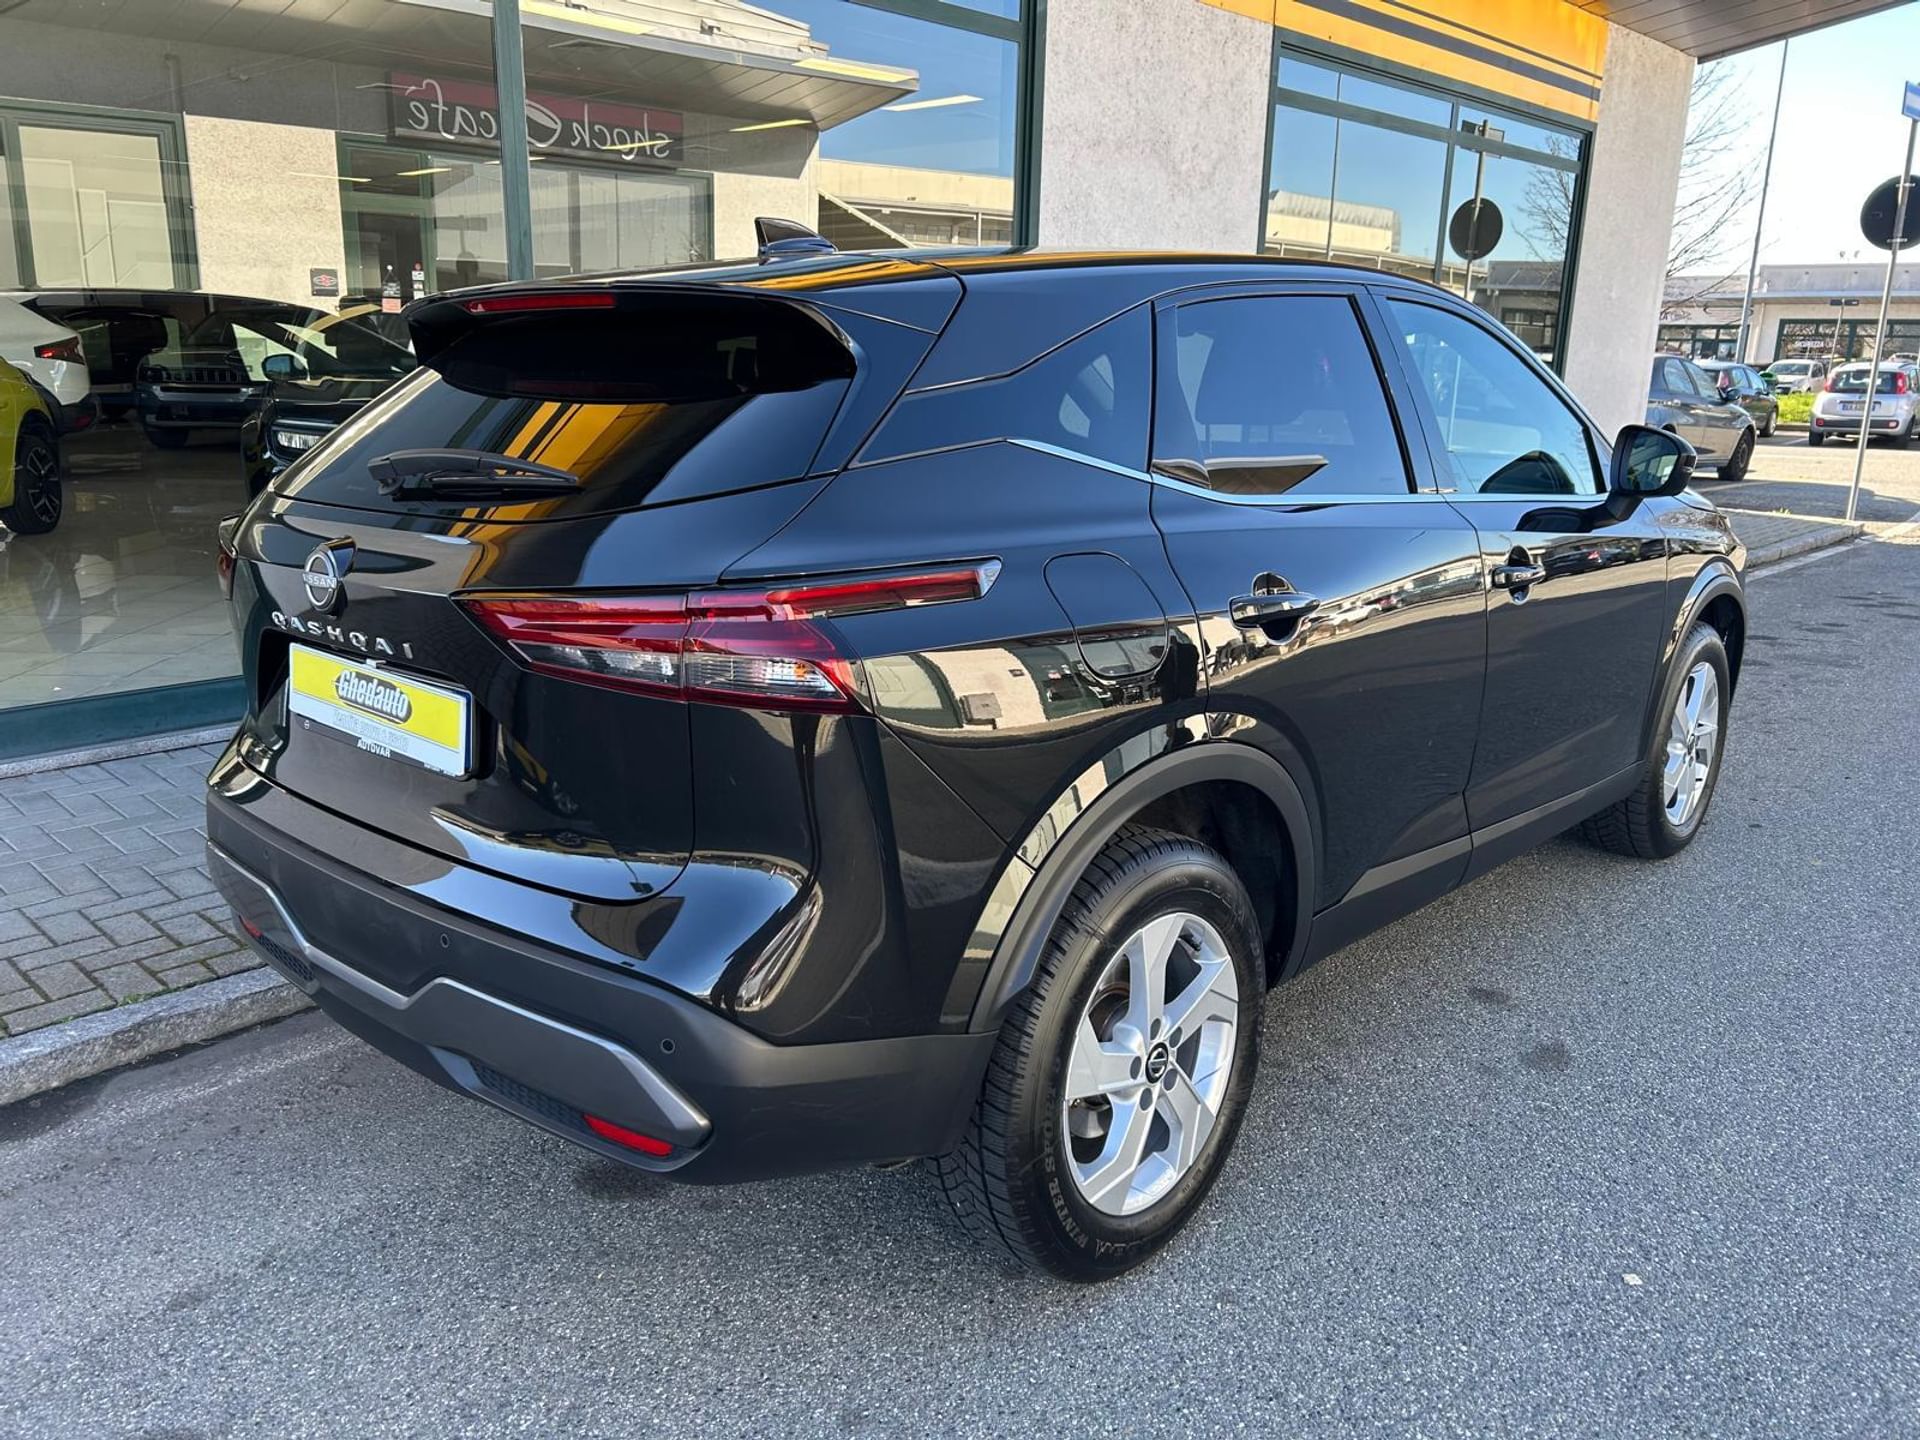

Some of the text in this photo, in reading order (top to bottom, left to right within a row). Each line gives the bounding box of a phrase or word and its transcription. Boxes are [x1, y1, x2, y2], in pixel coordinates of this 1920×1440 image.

[271, 611, 414, 660] QASHQAI
[338, 670, 409, 719] Ghedauto
[356, 738, 391, 759] AUTOVAR
